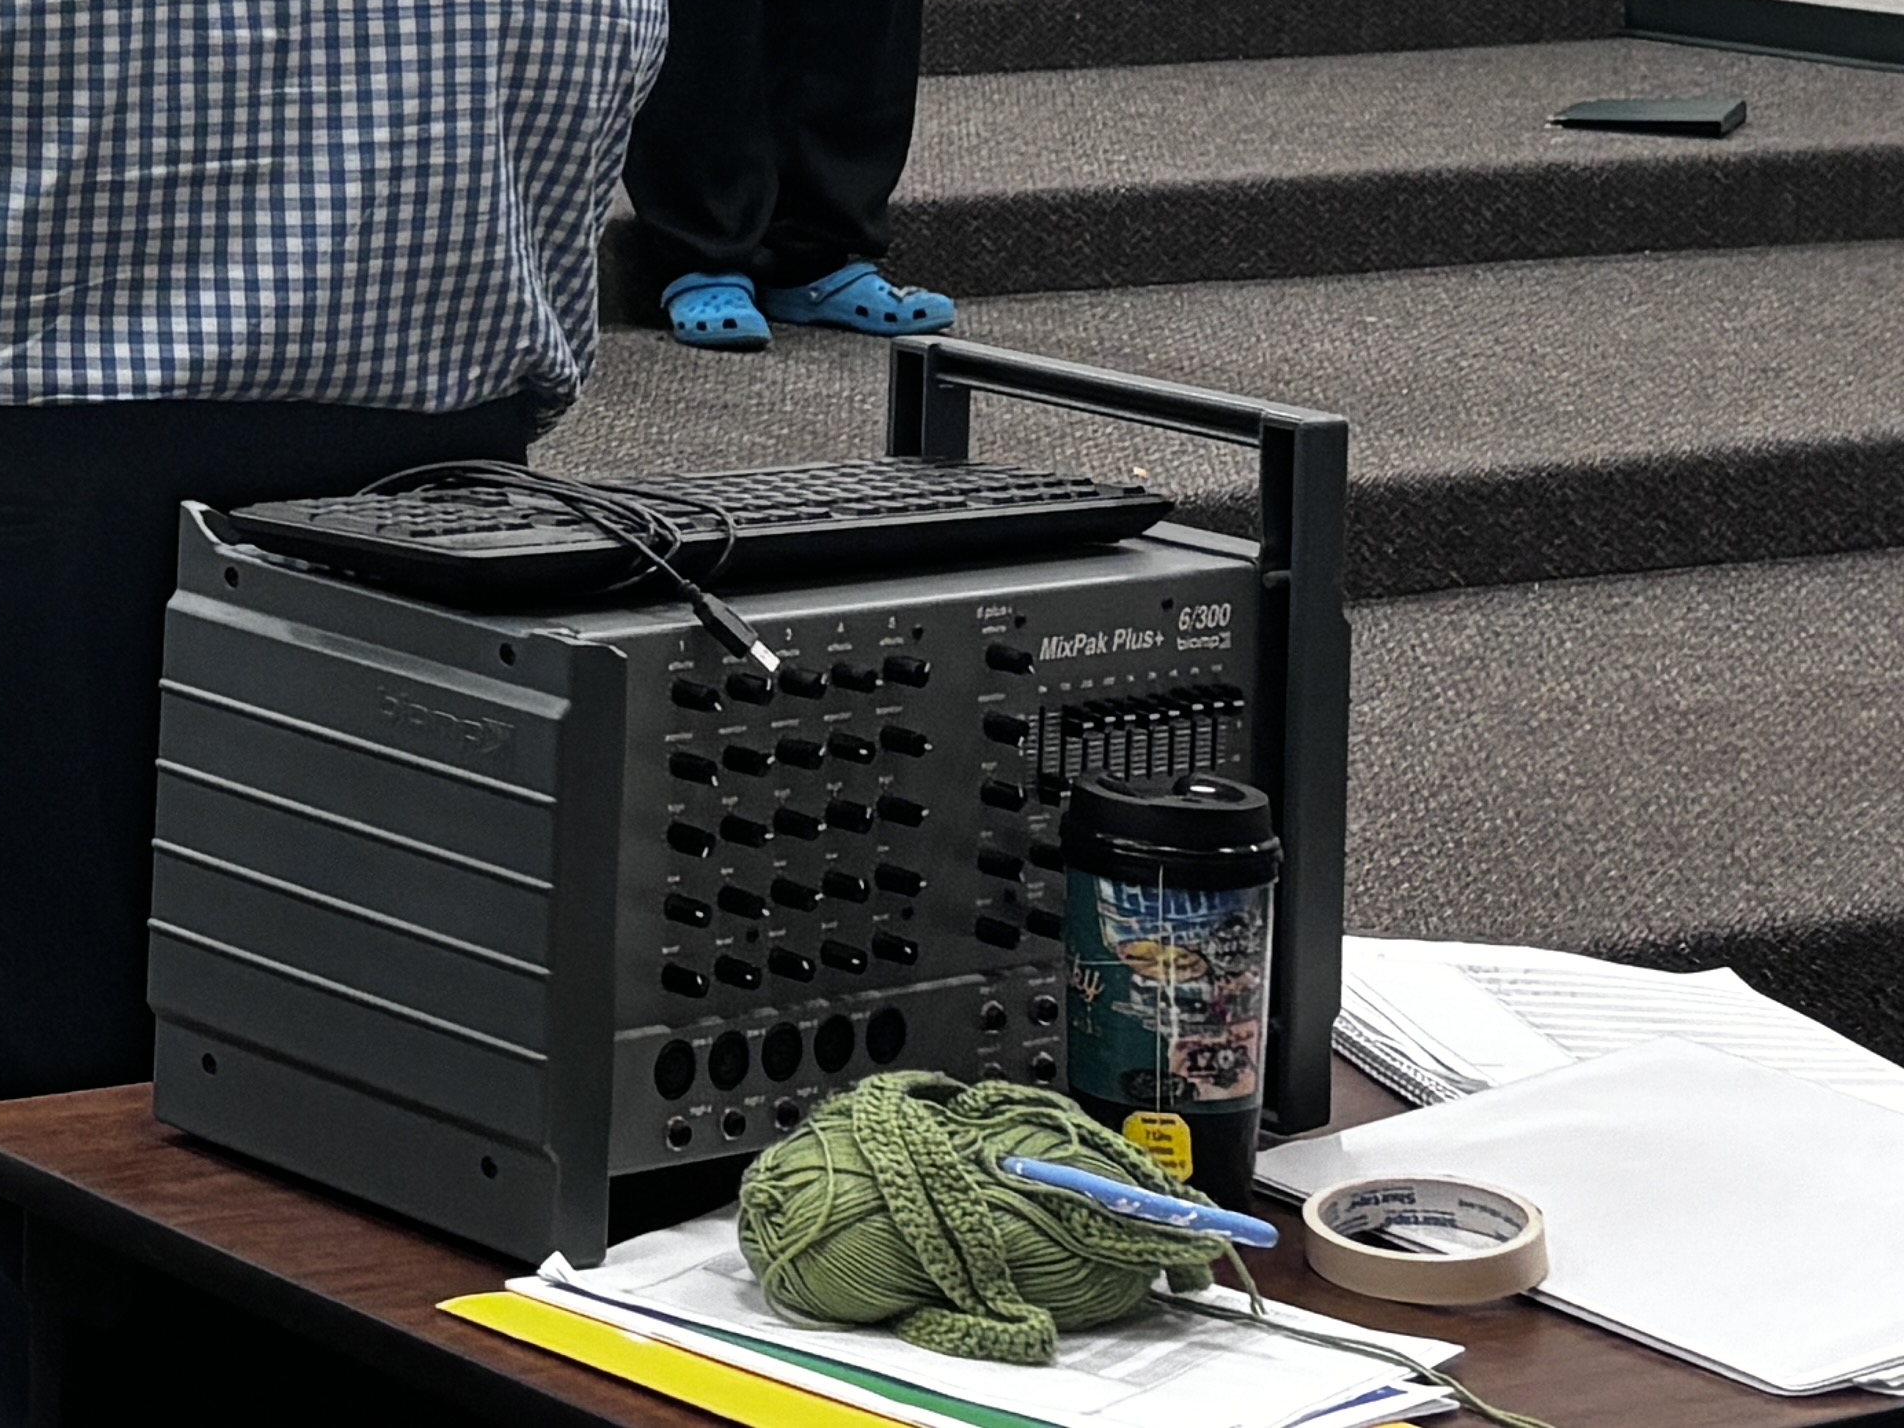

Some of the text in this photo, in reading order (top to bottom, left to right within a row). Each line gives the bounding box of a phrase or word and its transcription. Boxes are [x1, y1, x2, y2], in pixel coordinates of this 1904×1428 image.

[1177, 602, 1232, 633] 6/300
[1039, 626, 1166, 661] MixPak Plus+
